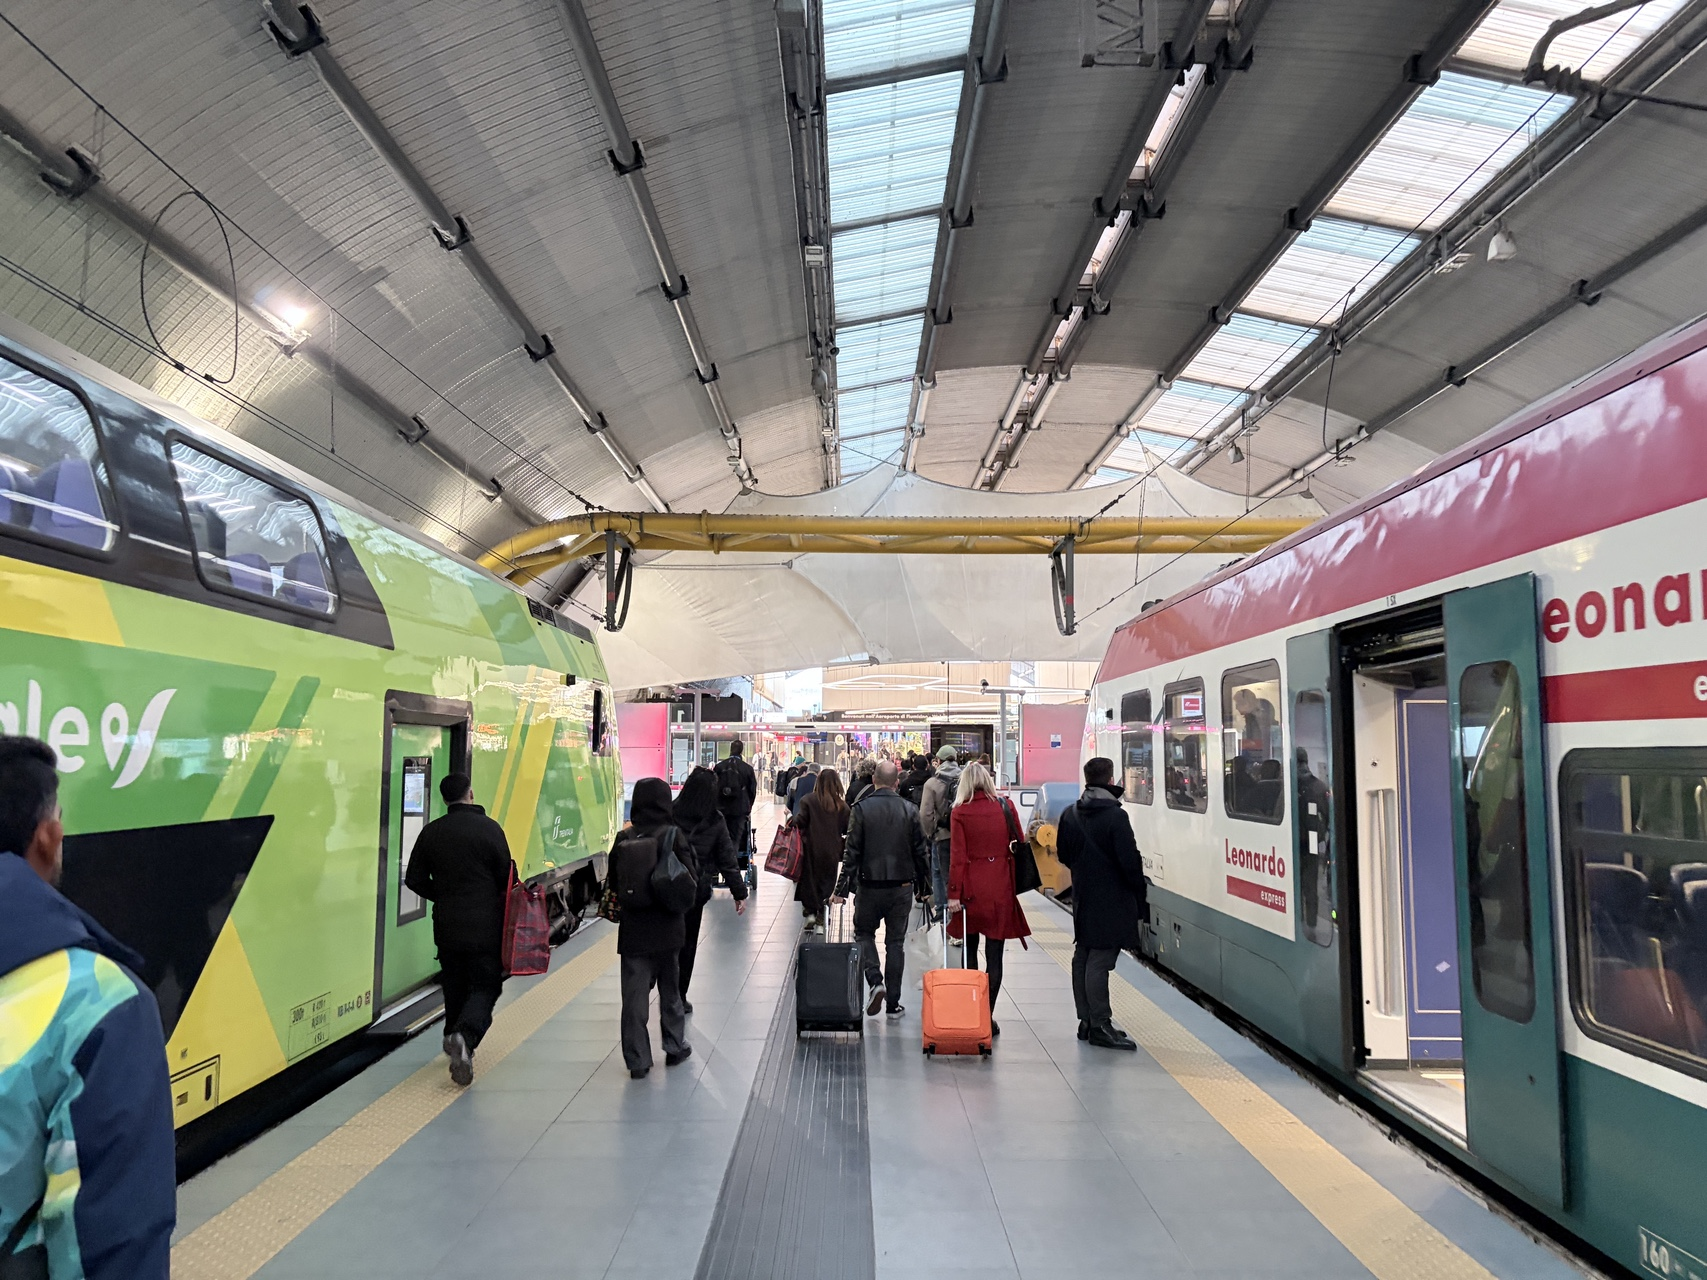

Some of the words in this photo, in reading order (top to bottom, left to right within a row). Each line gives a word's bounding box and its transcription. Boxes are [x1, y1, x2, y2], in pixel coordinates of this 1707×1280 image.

[1225, 838, 1286, 878] Leonardo
[1260, 890, 1285, 906] express
[1640, 1233, 1670, 1275] 160
